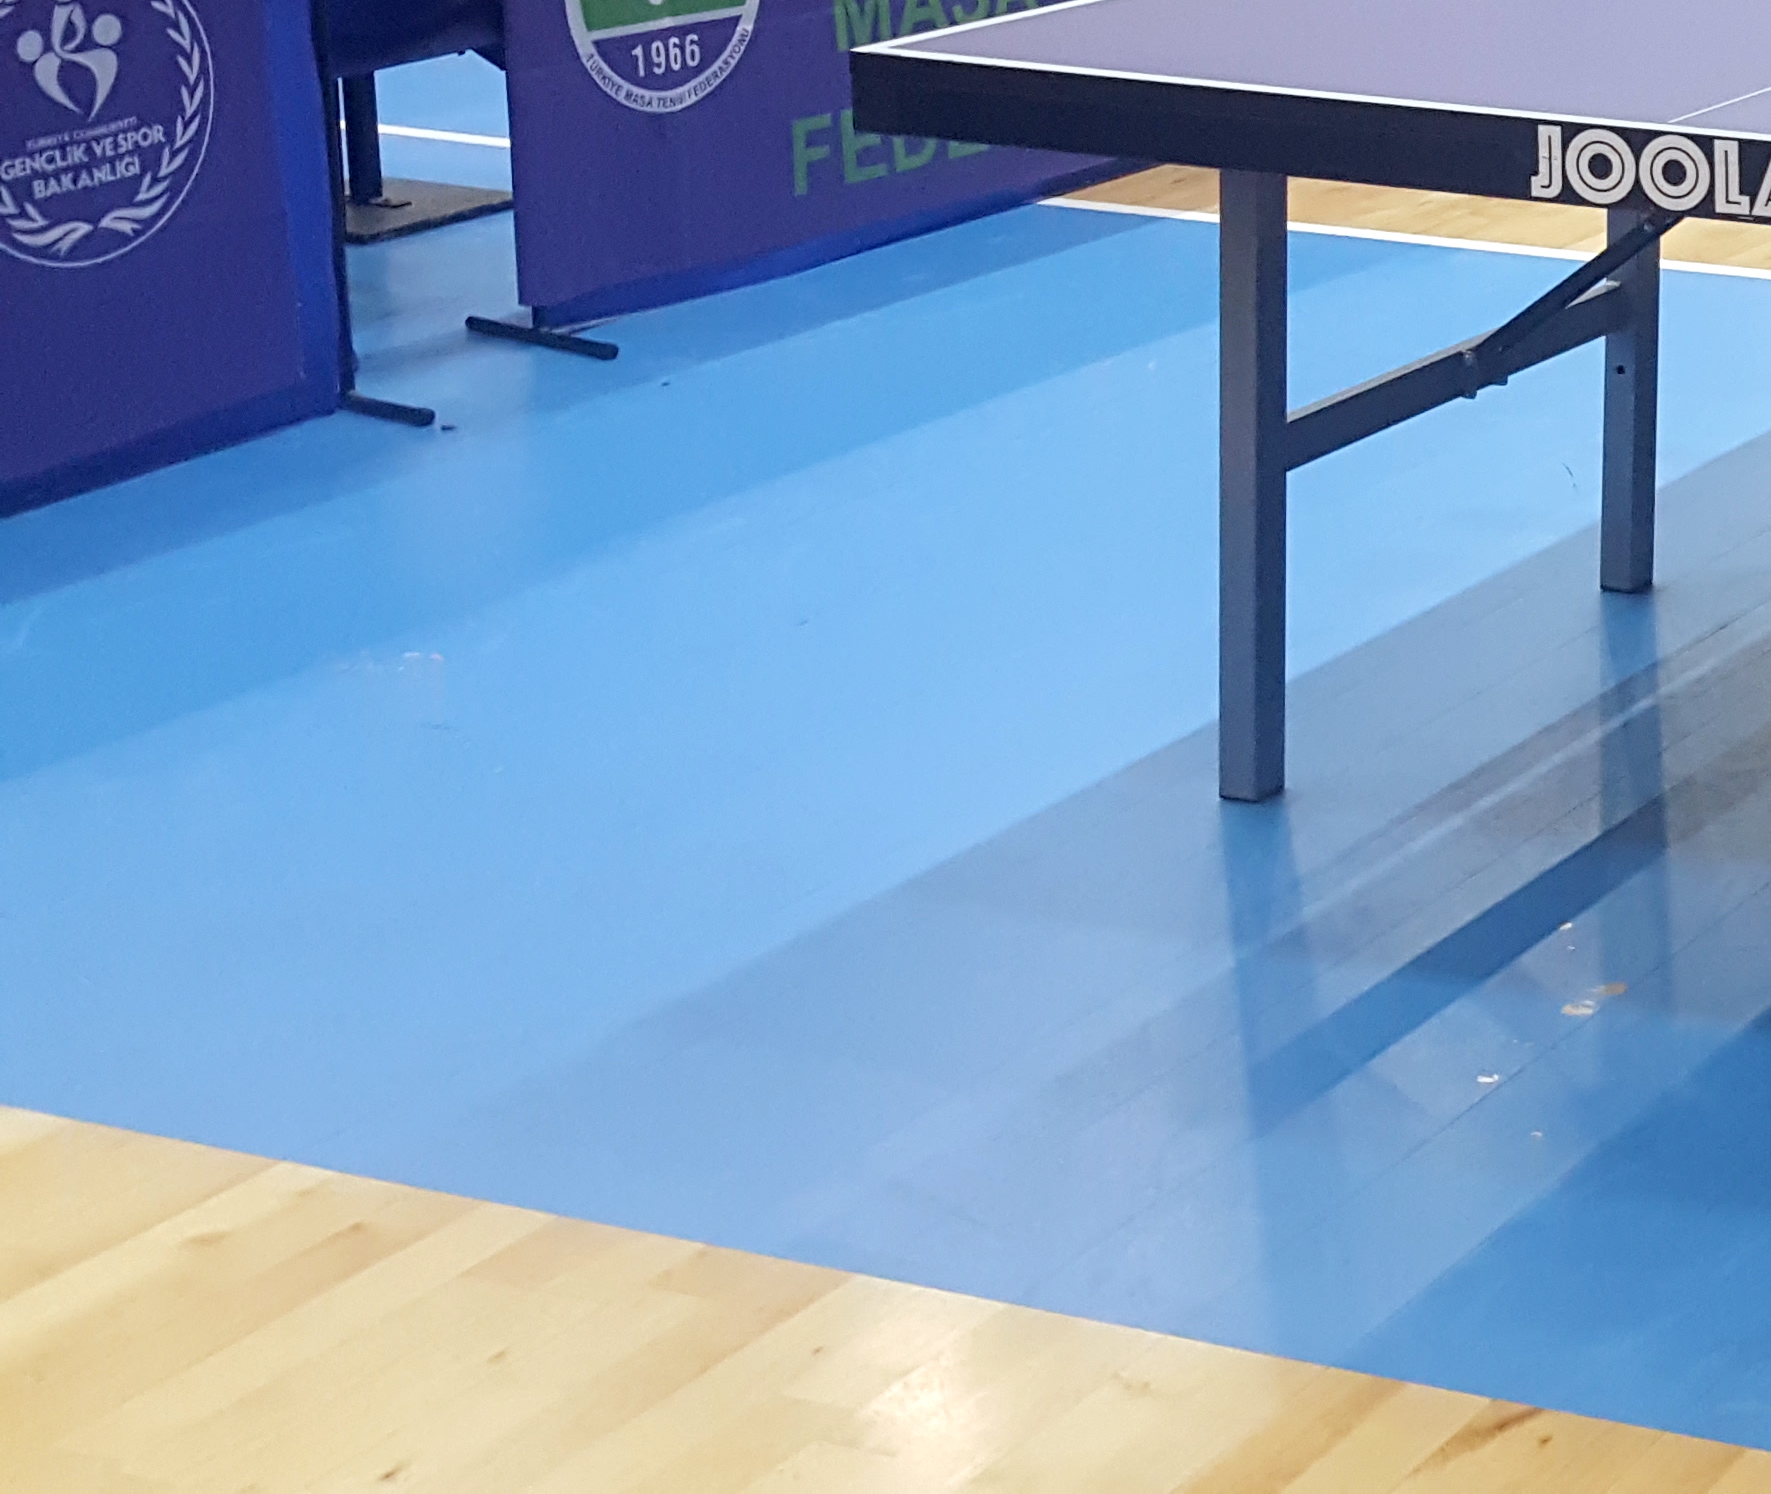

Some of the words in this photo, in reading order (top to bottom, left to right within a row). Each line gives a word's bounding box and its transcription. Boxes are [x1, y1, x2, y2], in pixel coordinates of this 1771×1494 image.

[624, 88, 653, 107] MASA
[686, 28, 750, 104] FEDERASYONU
[631, 33, 701, 78] 1966
[117, 124, 166, 154] SPOR
